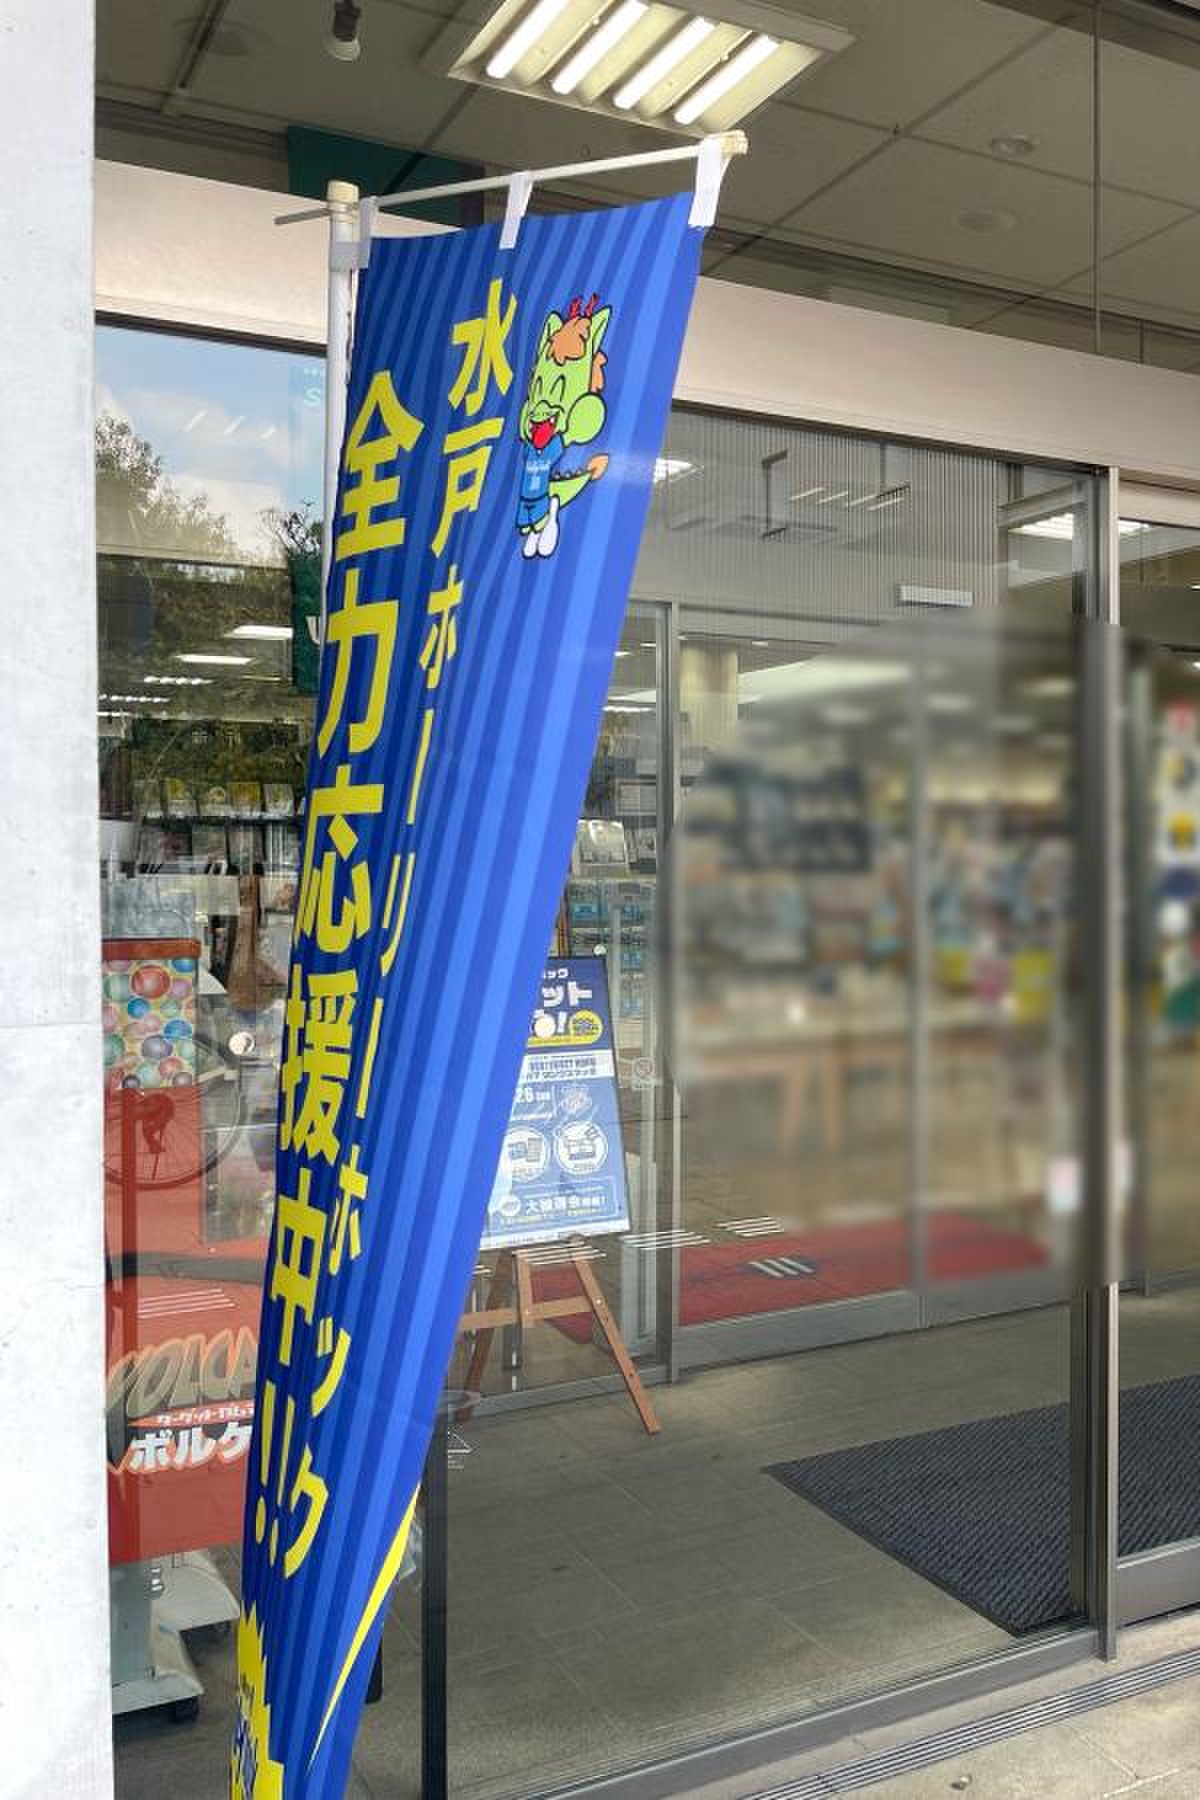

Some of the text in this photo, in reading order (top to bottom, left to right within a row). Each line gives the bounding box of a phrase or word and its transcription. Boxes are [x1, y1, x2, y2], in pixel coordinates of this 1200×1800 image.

[283, 277, 518, 1579] 水戸ホーリーホック
